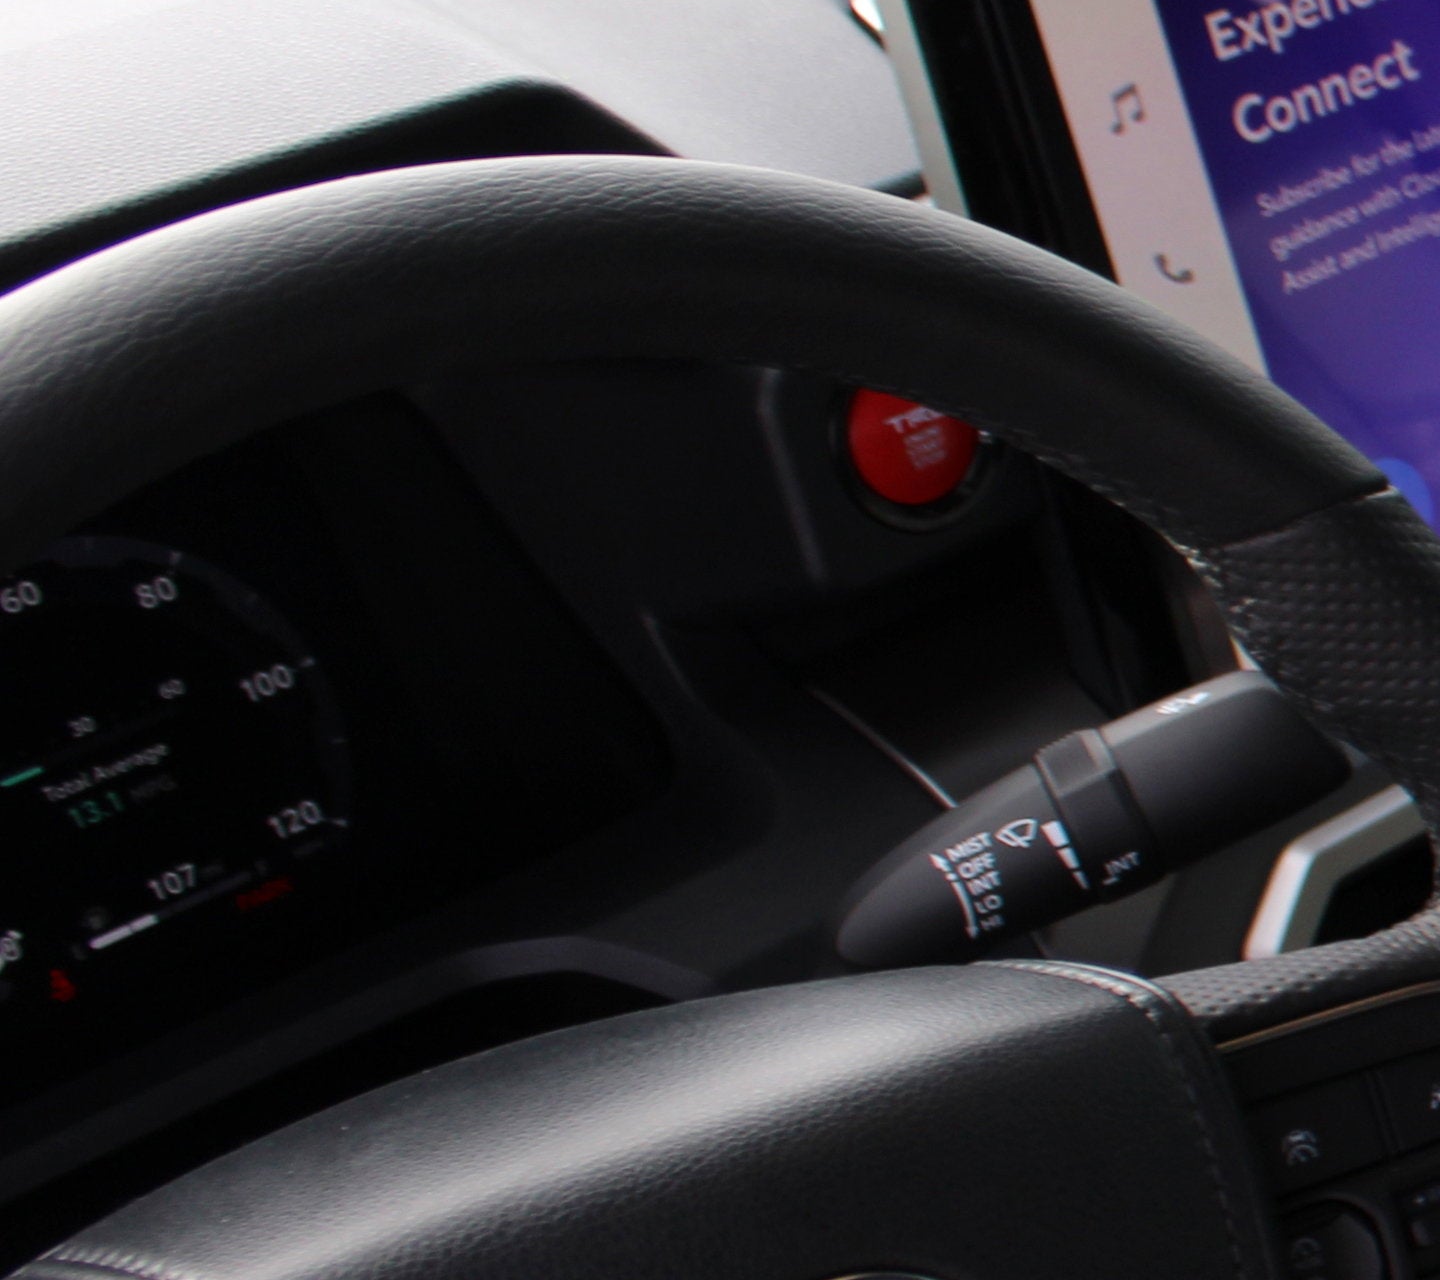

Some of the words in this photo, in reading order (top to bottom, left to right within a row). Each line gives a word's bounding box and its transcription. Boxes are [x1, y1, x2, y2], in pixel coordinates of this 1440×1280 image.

[1232, 39, 1421, 144] Connect
[1256, 167, 1353, 218] Subscribe
[1350, 153, 1381, 177] for
[1378, 138, 1416, 166] the
[1268, 206, 1361, 263] guidance
[1357, 185, 1402, 217] with
[1282, 255, 1342, 296] Assist
[1338, 234, 1380, 270] and
[0, 579, 43, 614] 60
[133, 575, 179, 609] 80
[238, 663, 296, 703] 100
[265, 799, 323, 840] 120
[945, 831, 993, 863] MIST
[956, 851, 997, 880] OFF
[146, 862, 197, 901] 107
[965, 870, 1003, 897] INT
[973, 893, 1005, 915] LO
